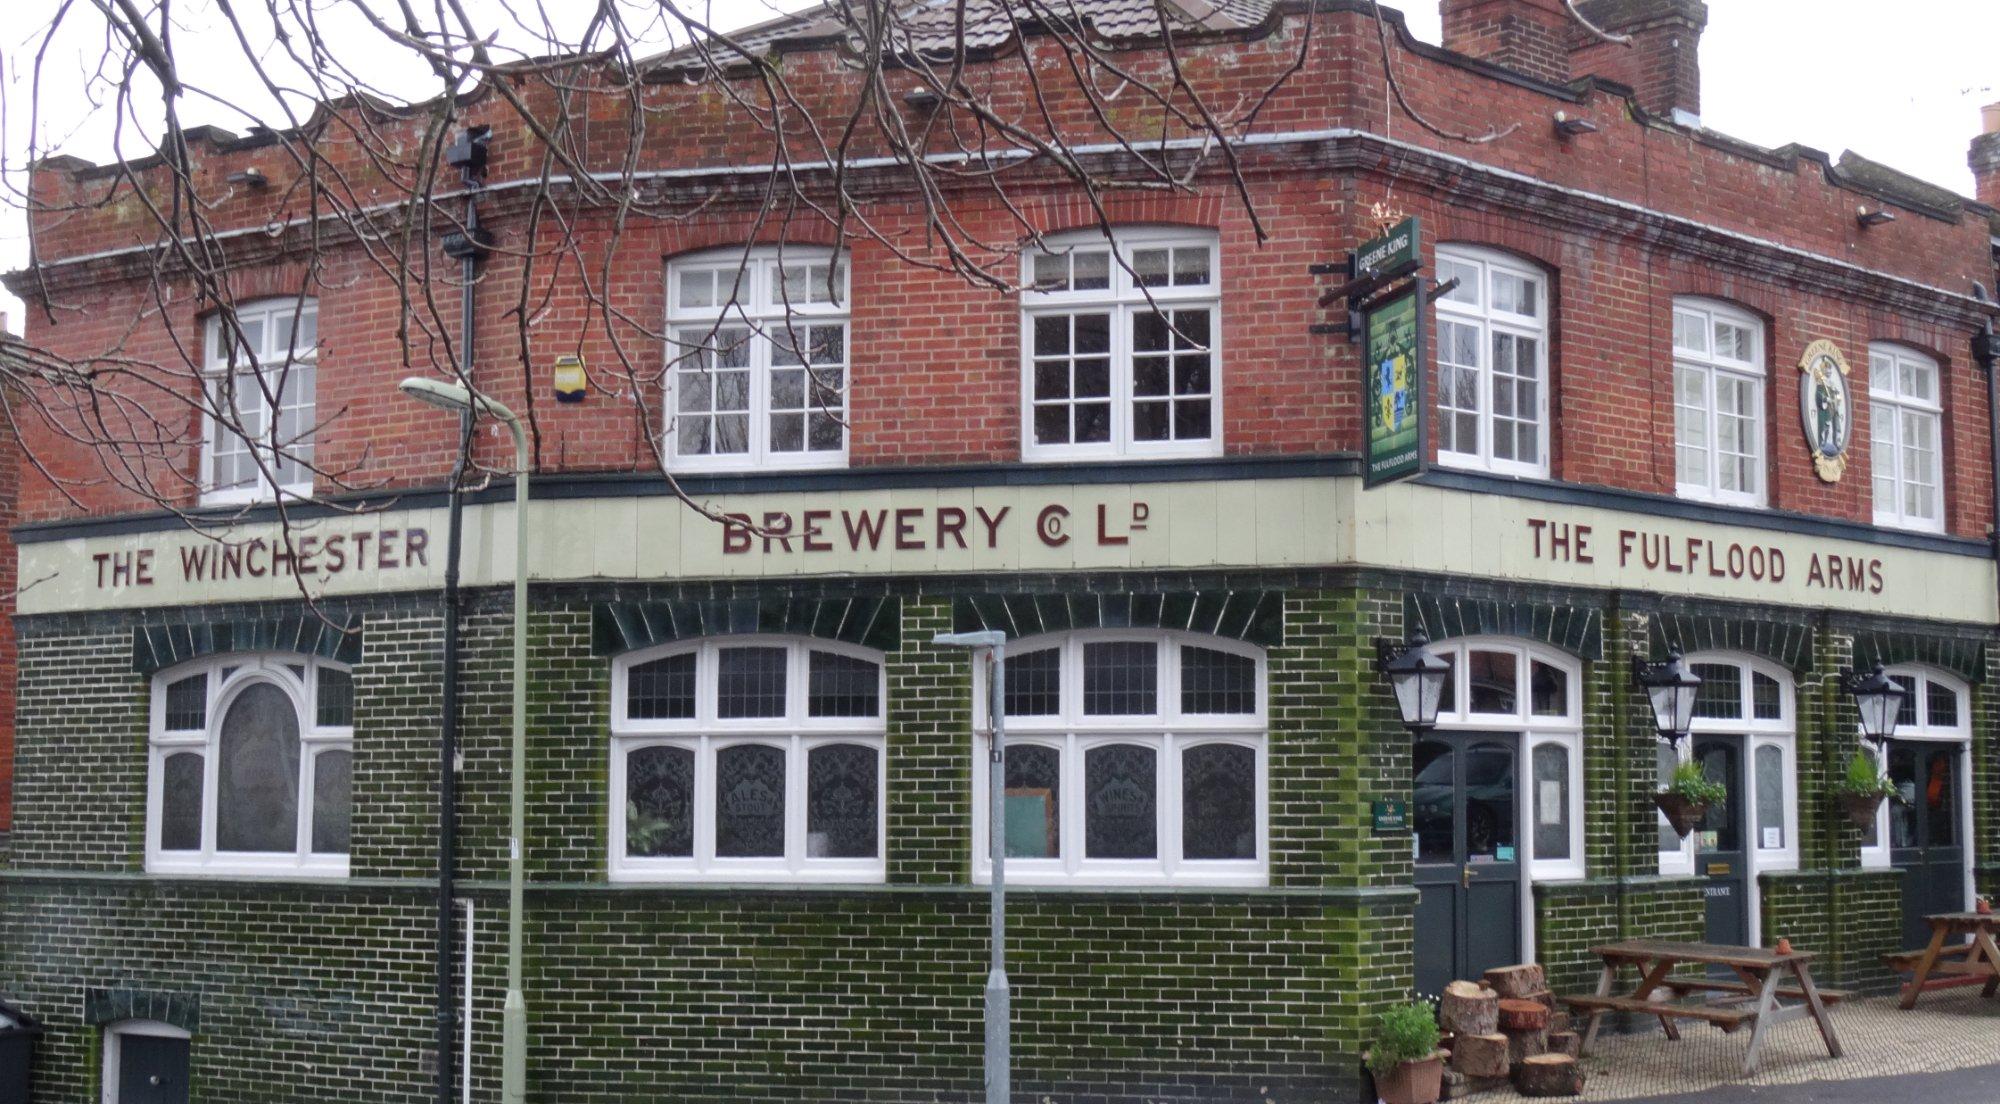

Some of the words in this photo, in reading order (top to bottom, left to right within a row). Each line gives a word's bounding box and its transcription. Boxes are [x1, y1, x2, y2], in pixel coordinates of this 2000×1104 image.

[1359, 245, 1386, 270] GREENE
[1388, 234, 1408, 255] KING
[92, 549, 155, 589] THE
[180, 528, 429, 582] WINCHESTER
[722, 505, 1011, 554] BREWERY
[1527, 518, 1594, 563] THE
[1618, 529, 1785, 582] FULFLOOD
[1806, 553, 1884, 594] ARMS
[1704, 887, 1729, 896] NTRANCE
